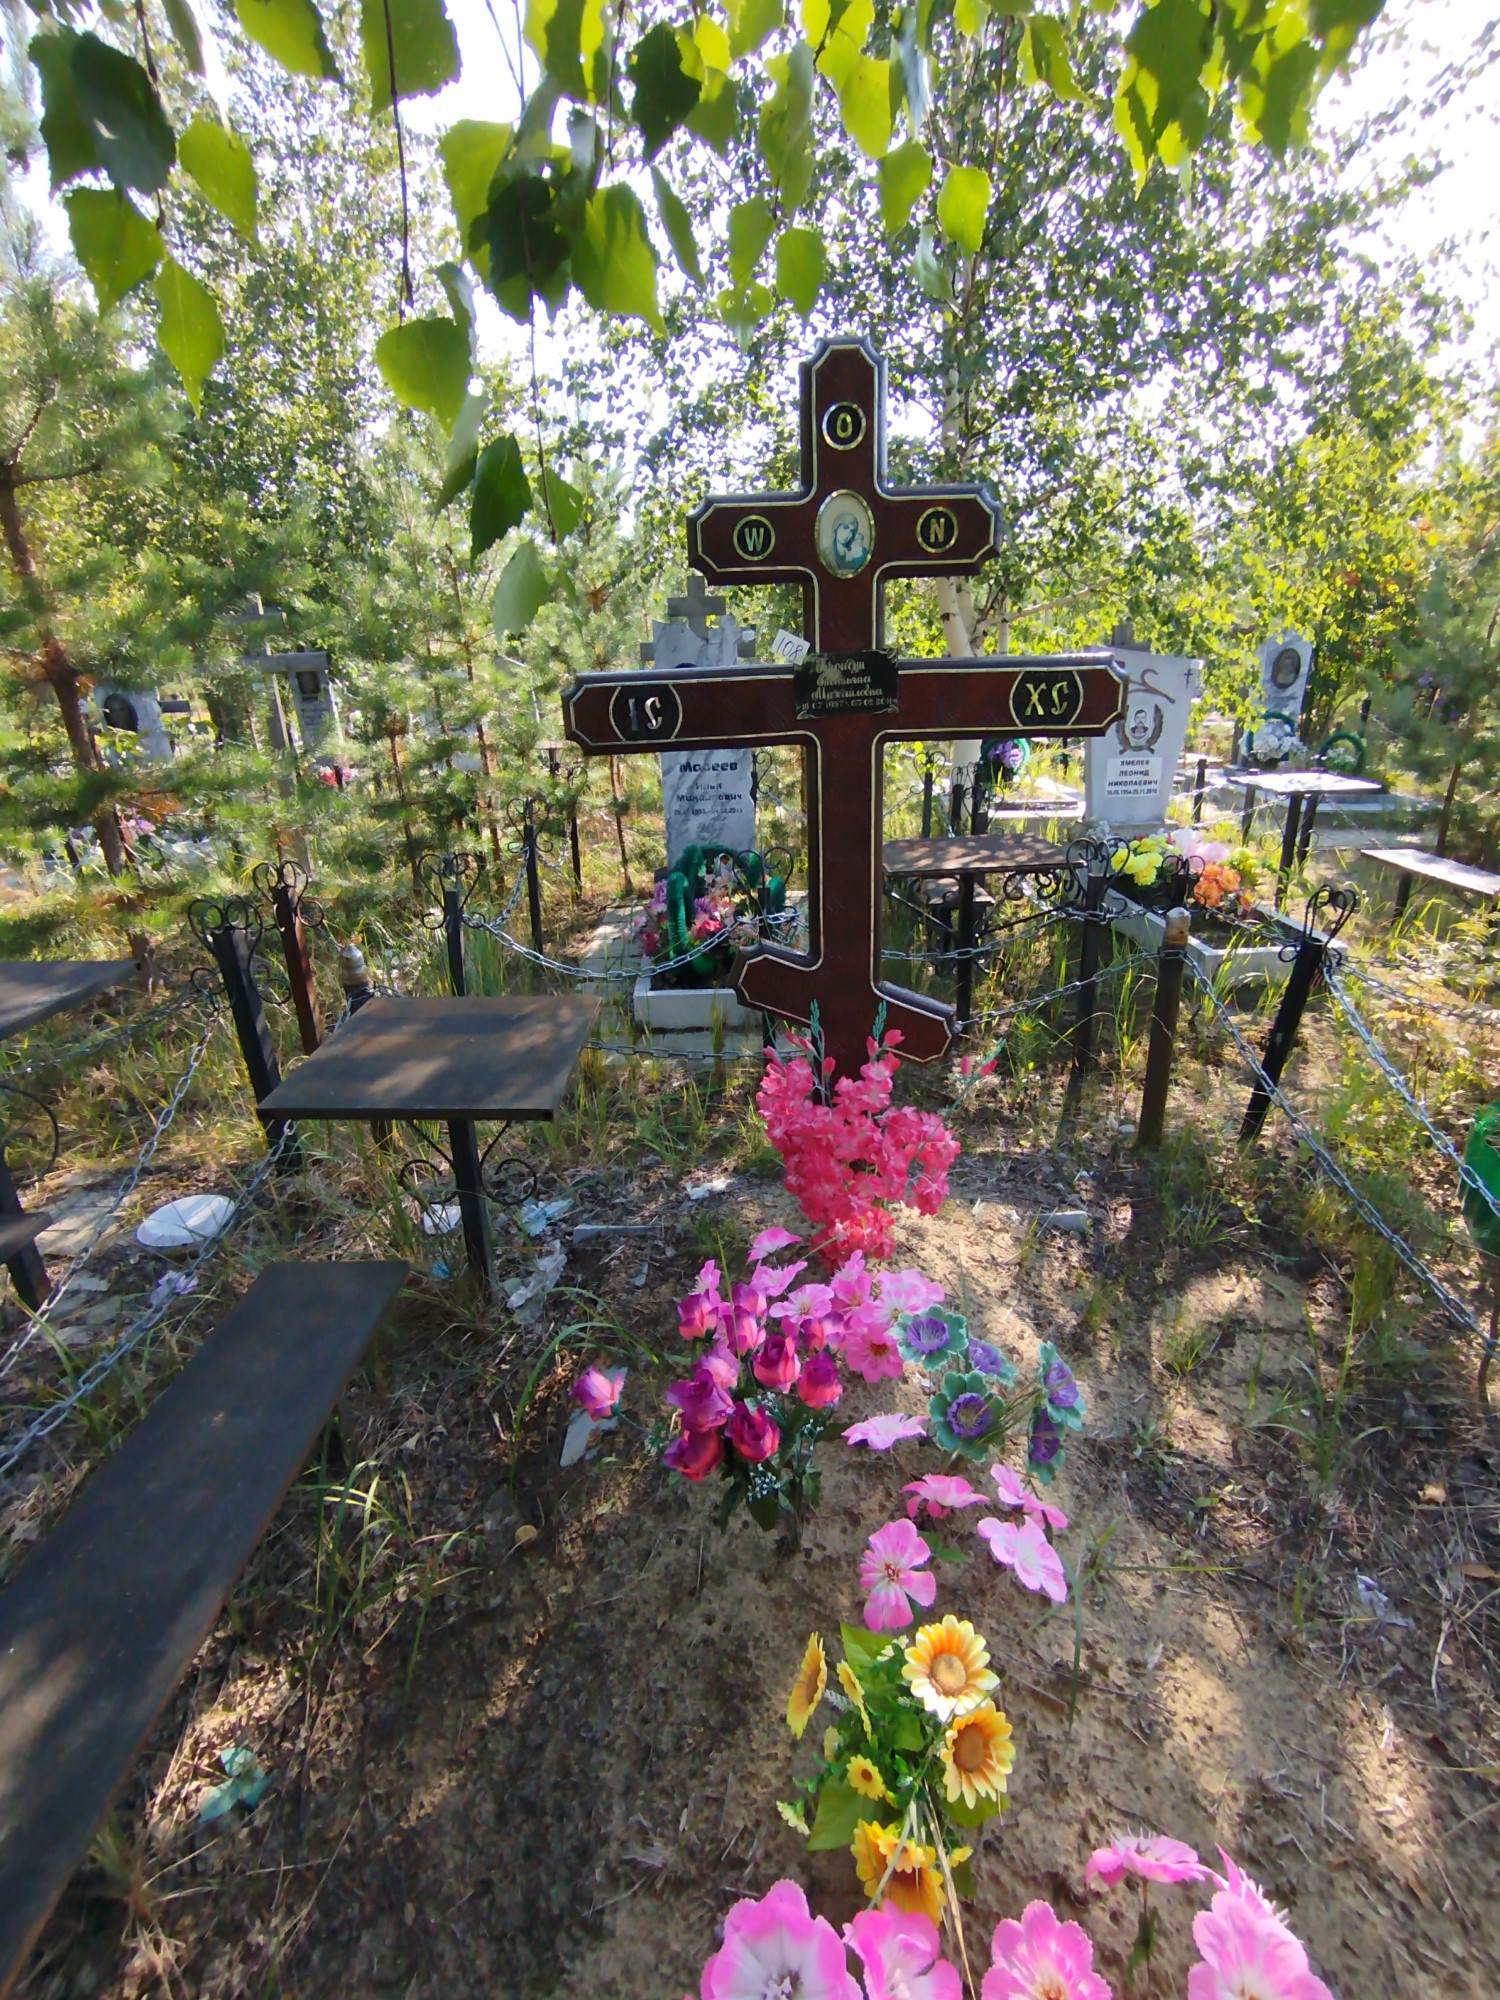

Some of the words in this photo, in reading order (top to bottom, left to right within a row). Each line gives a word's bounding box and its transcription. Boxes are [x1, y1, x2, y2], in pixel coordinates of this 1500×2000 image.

[776, 636, 804, 661] 108
[1119, 769, 1149, 777] ЛЕОНИД
[1107, 779, 1158, 787] НИКОЛАЕВИЧ
[676, 794, 742, 802] Михаович
